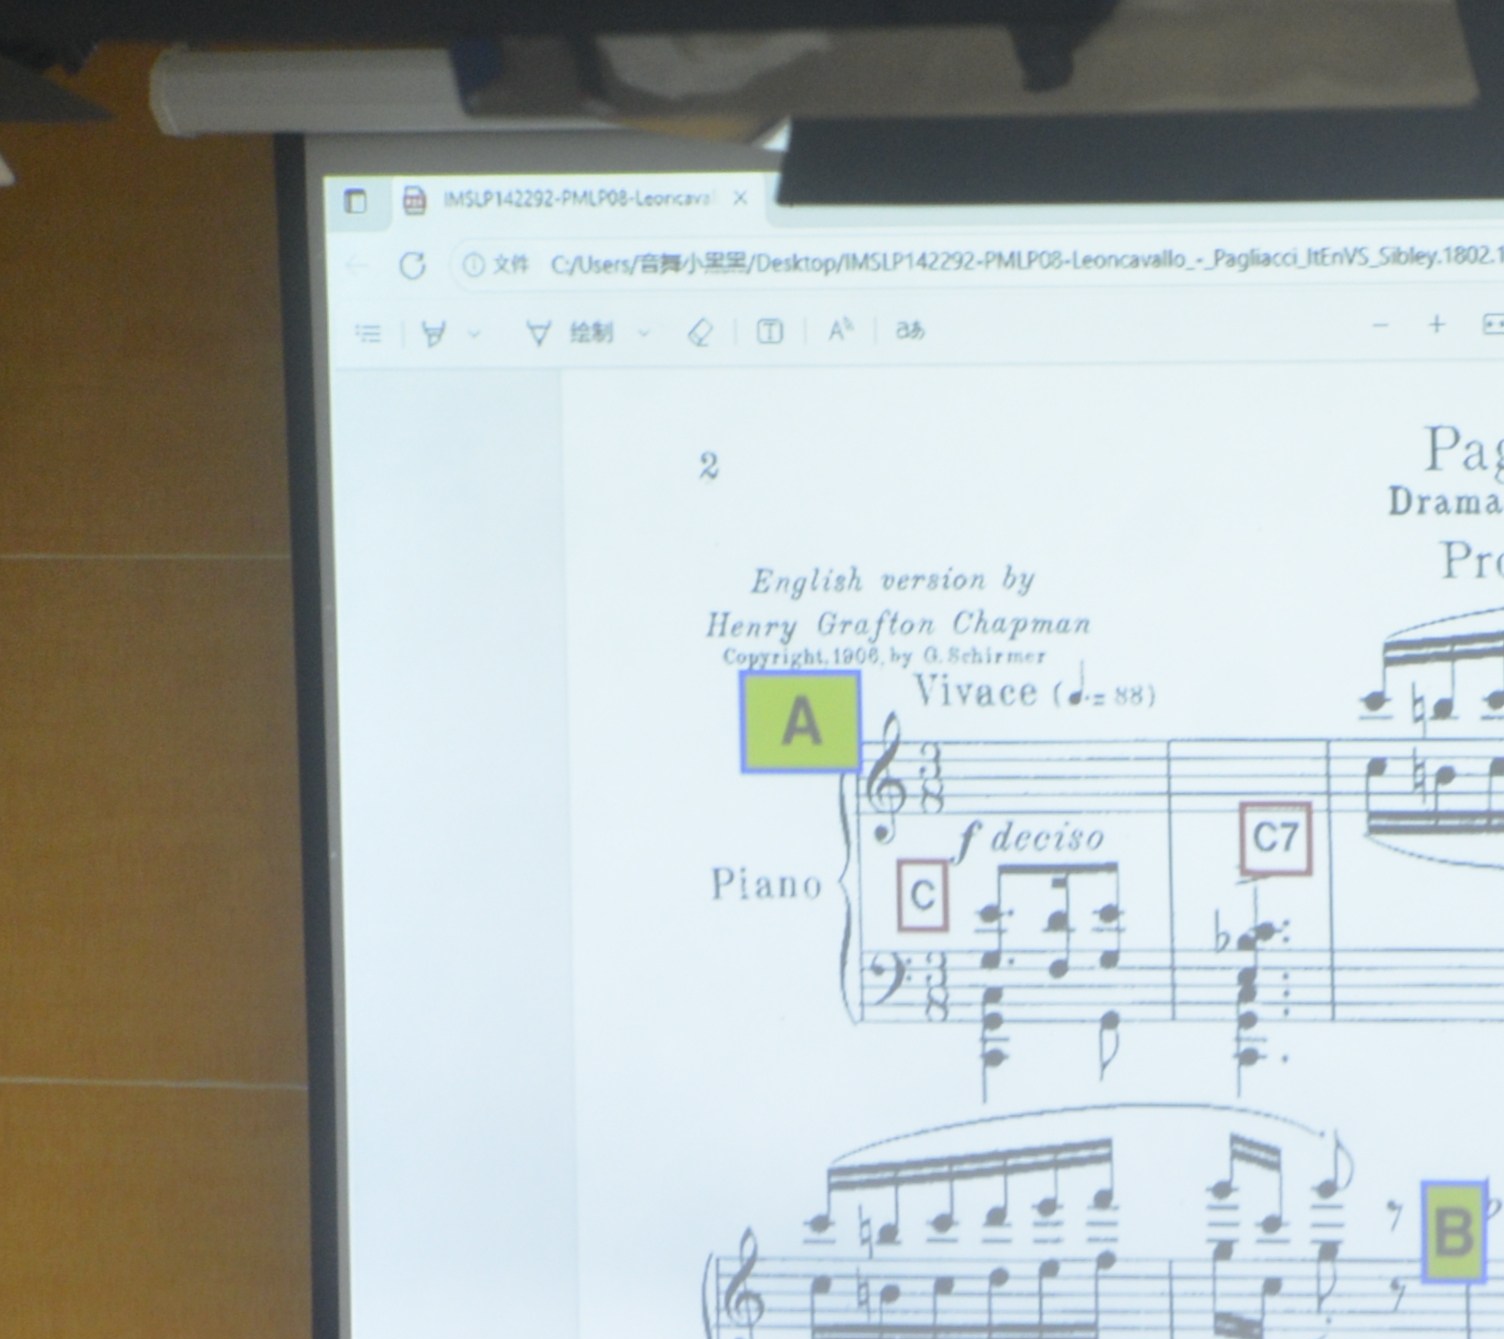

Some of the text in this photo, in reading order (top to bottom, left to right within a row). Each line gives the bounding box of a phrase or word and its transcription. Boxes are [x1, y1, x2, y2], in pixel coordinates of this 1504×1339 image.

[569, 319, 615, 344] 绘制
[699, 450, 720, 480] 2
[1388, 484, 1503, 517] Drama
[750, 563, 1036, 600] English version by
[704, 608, 1092, 645] Henry Grafton Chapman
[912, 672, 1039, 708] Vivace
[780, 693, 824, 747] A
[990, 820, 1105, 853] deciso
[1251, 821, 1301, 852] C7
[710, 866, 823, 900] Piano
[910, 879, 936, 911] C
[1434, 1206, 1475, 1258] B
